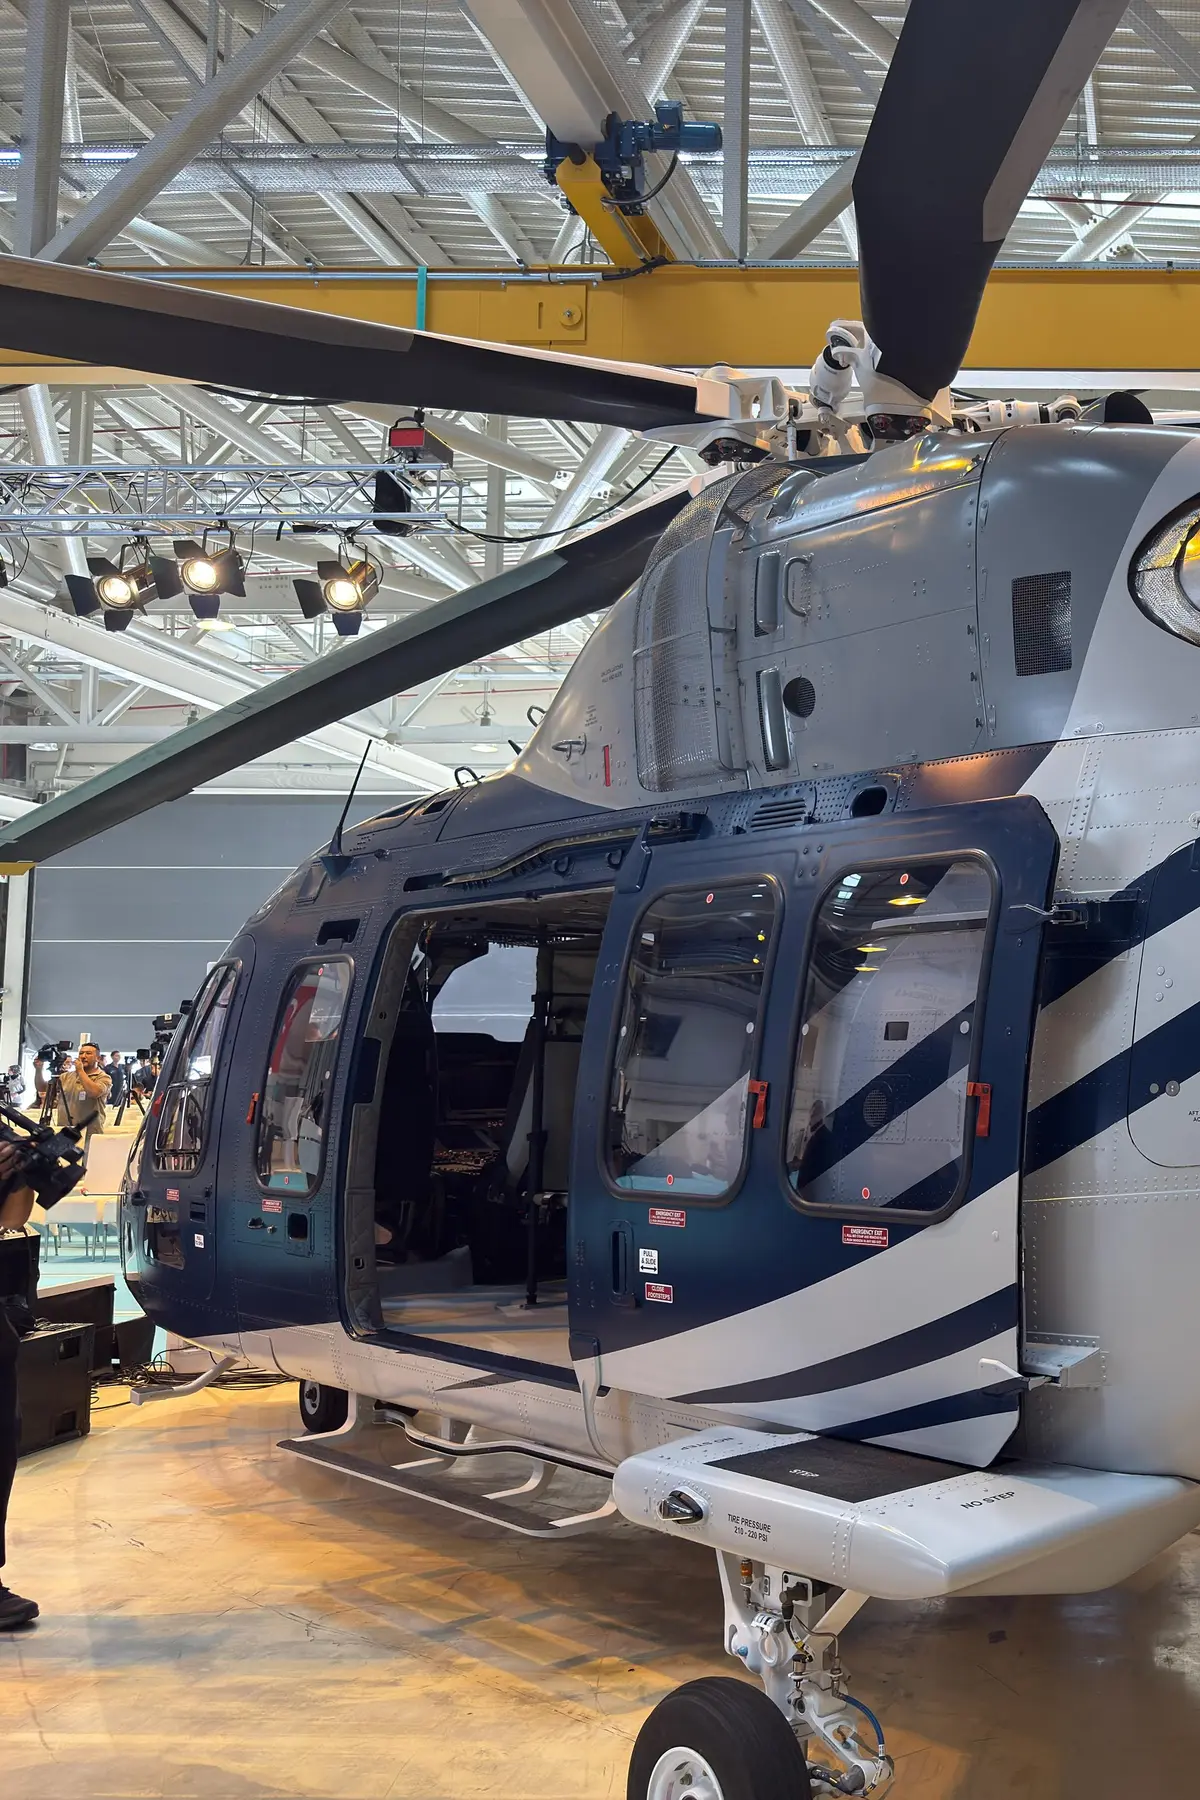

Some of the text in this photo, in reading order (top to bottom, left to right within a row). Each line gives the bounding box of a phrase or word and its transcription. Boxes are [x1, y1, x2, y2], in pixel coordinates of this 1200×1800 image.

[789, 1468, 820, 1478] STEP
[960, 1491, 1015, 1510] NO STEP
[727, 1513, 771, 1534] TIRE PRESSURE
[747, 1529, 758, 1540] 220
[758, 1532, 768, 1543] PSI
